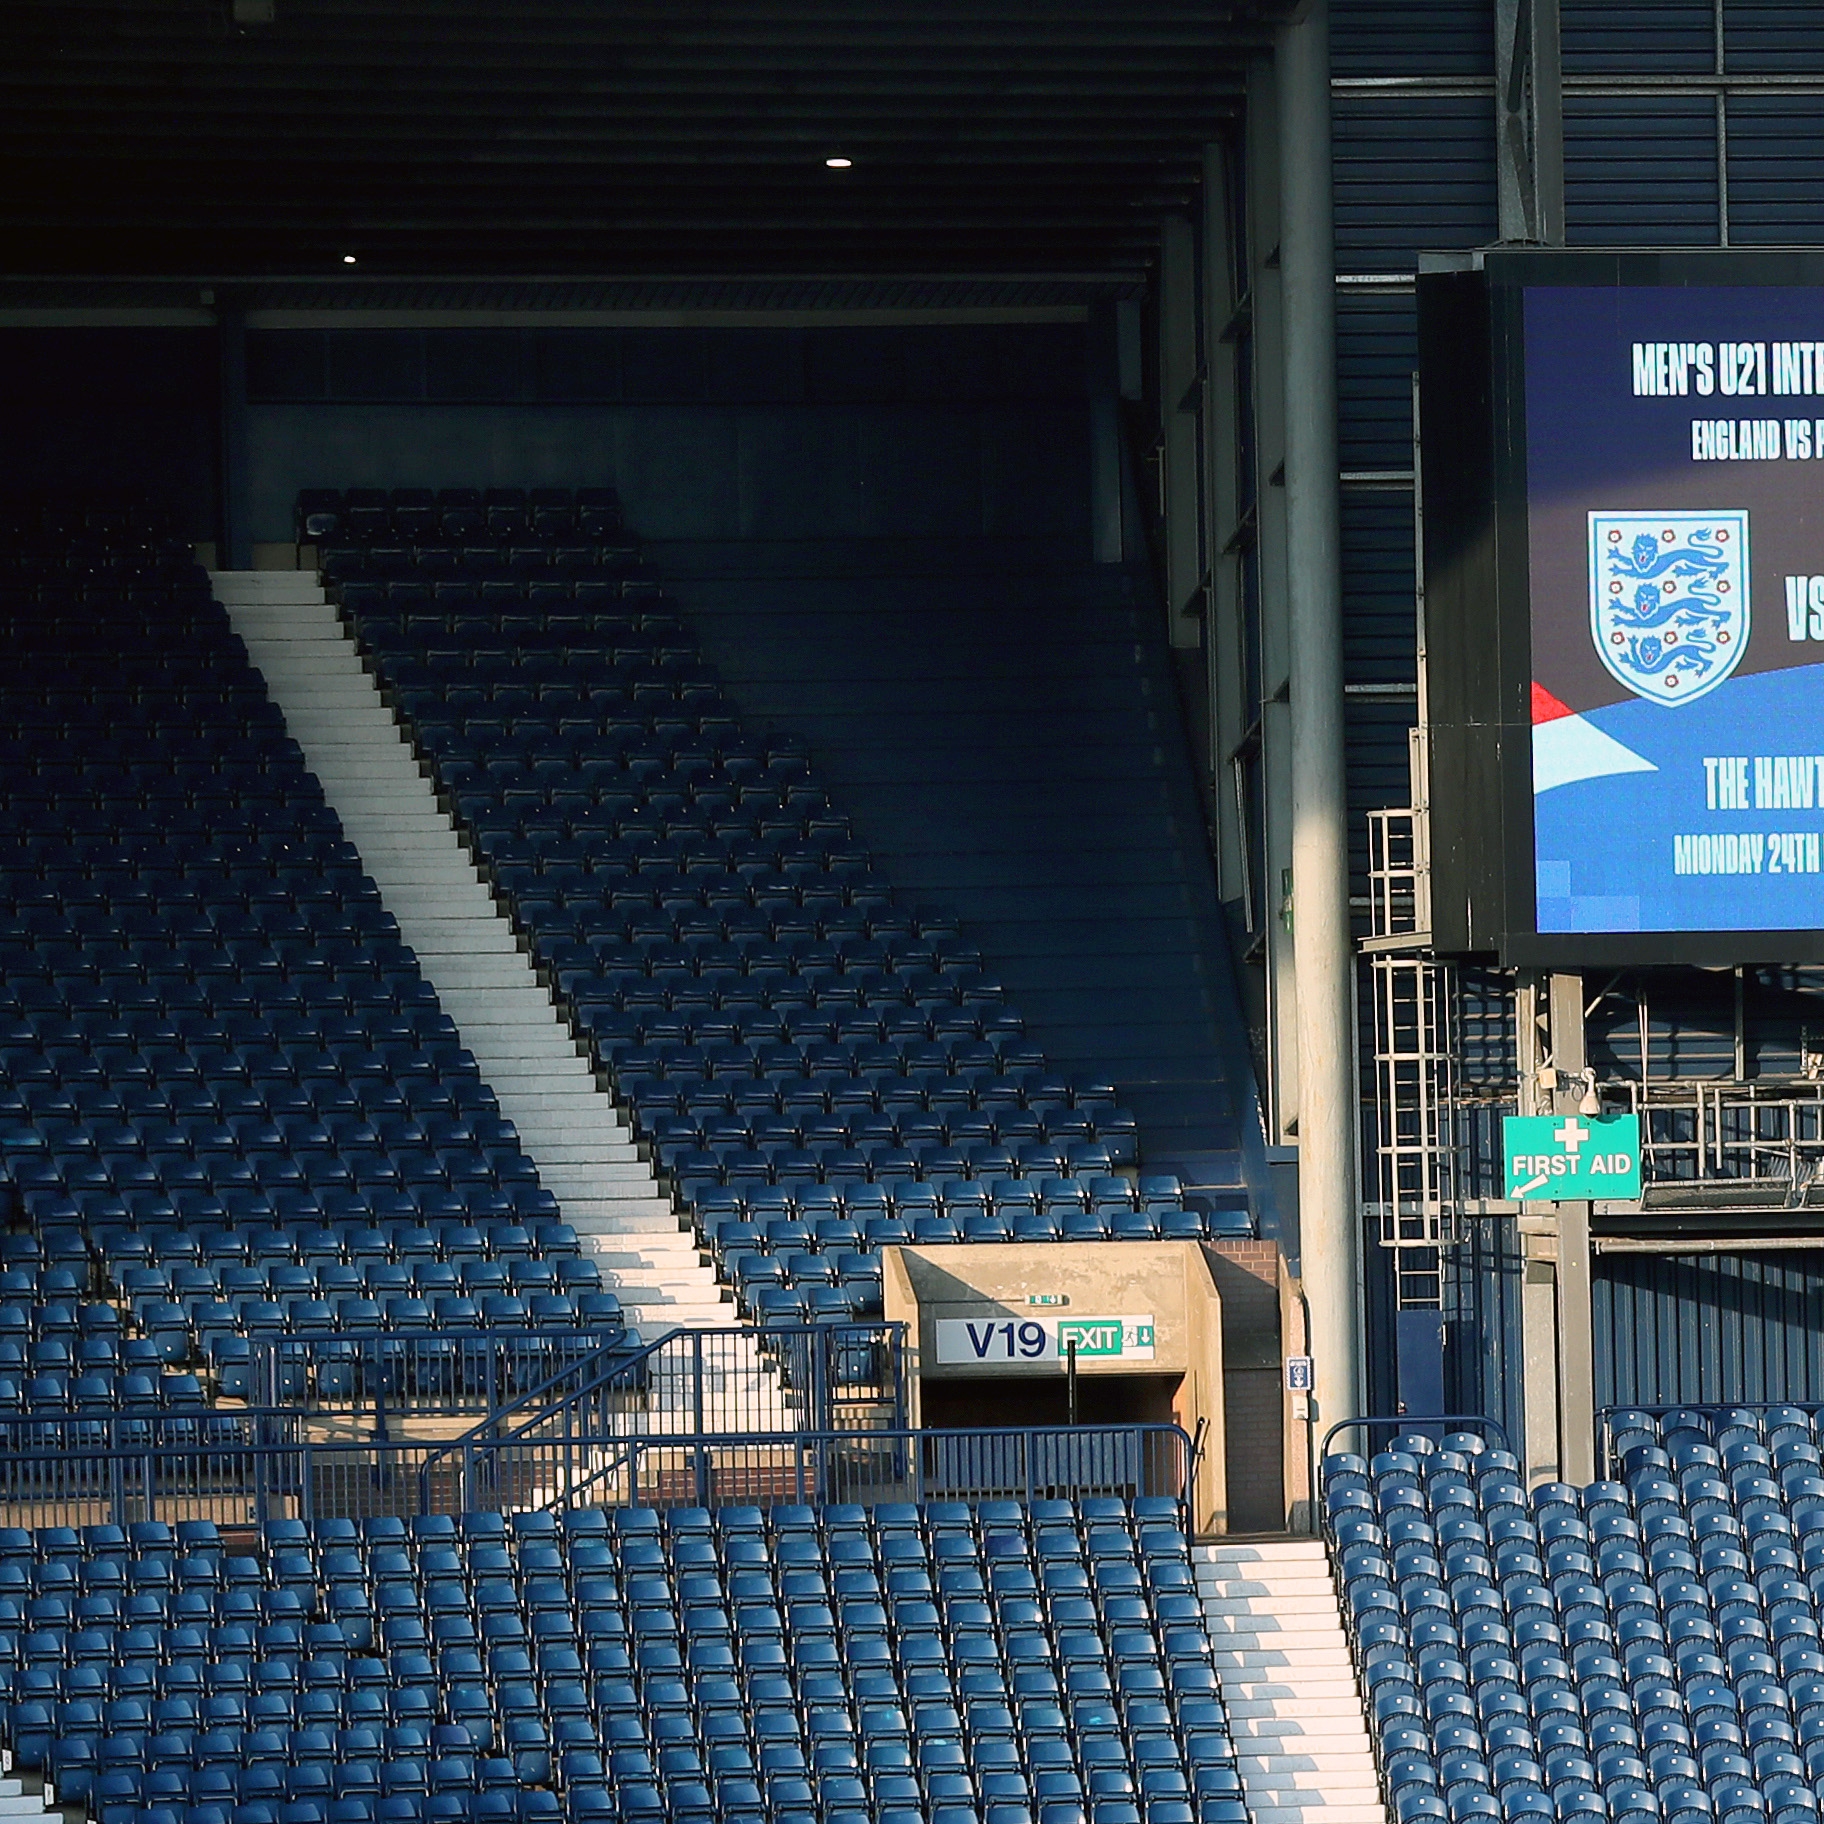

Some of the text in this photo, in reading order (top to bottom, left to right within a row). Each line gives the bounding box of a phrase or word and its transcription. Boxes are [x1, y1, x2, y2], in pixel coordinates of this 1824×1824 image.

[1633, 343, 1713, 396] MEN'S
[1719, 342, 1766, 395] U21
[1692, 420, 1780, 460] ENGLAND
[1784, 419, 1813, 459] VS
[1703, 756, 1749, 810] THE
[1768, 832, 1820, 873] 24TH
[1513, 1153, 1632, 1176] FIRST AID
[966, 1321, 1119, 1358] V19 EXIT
